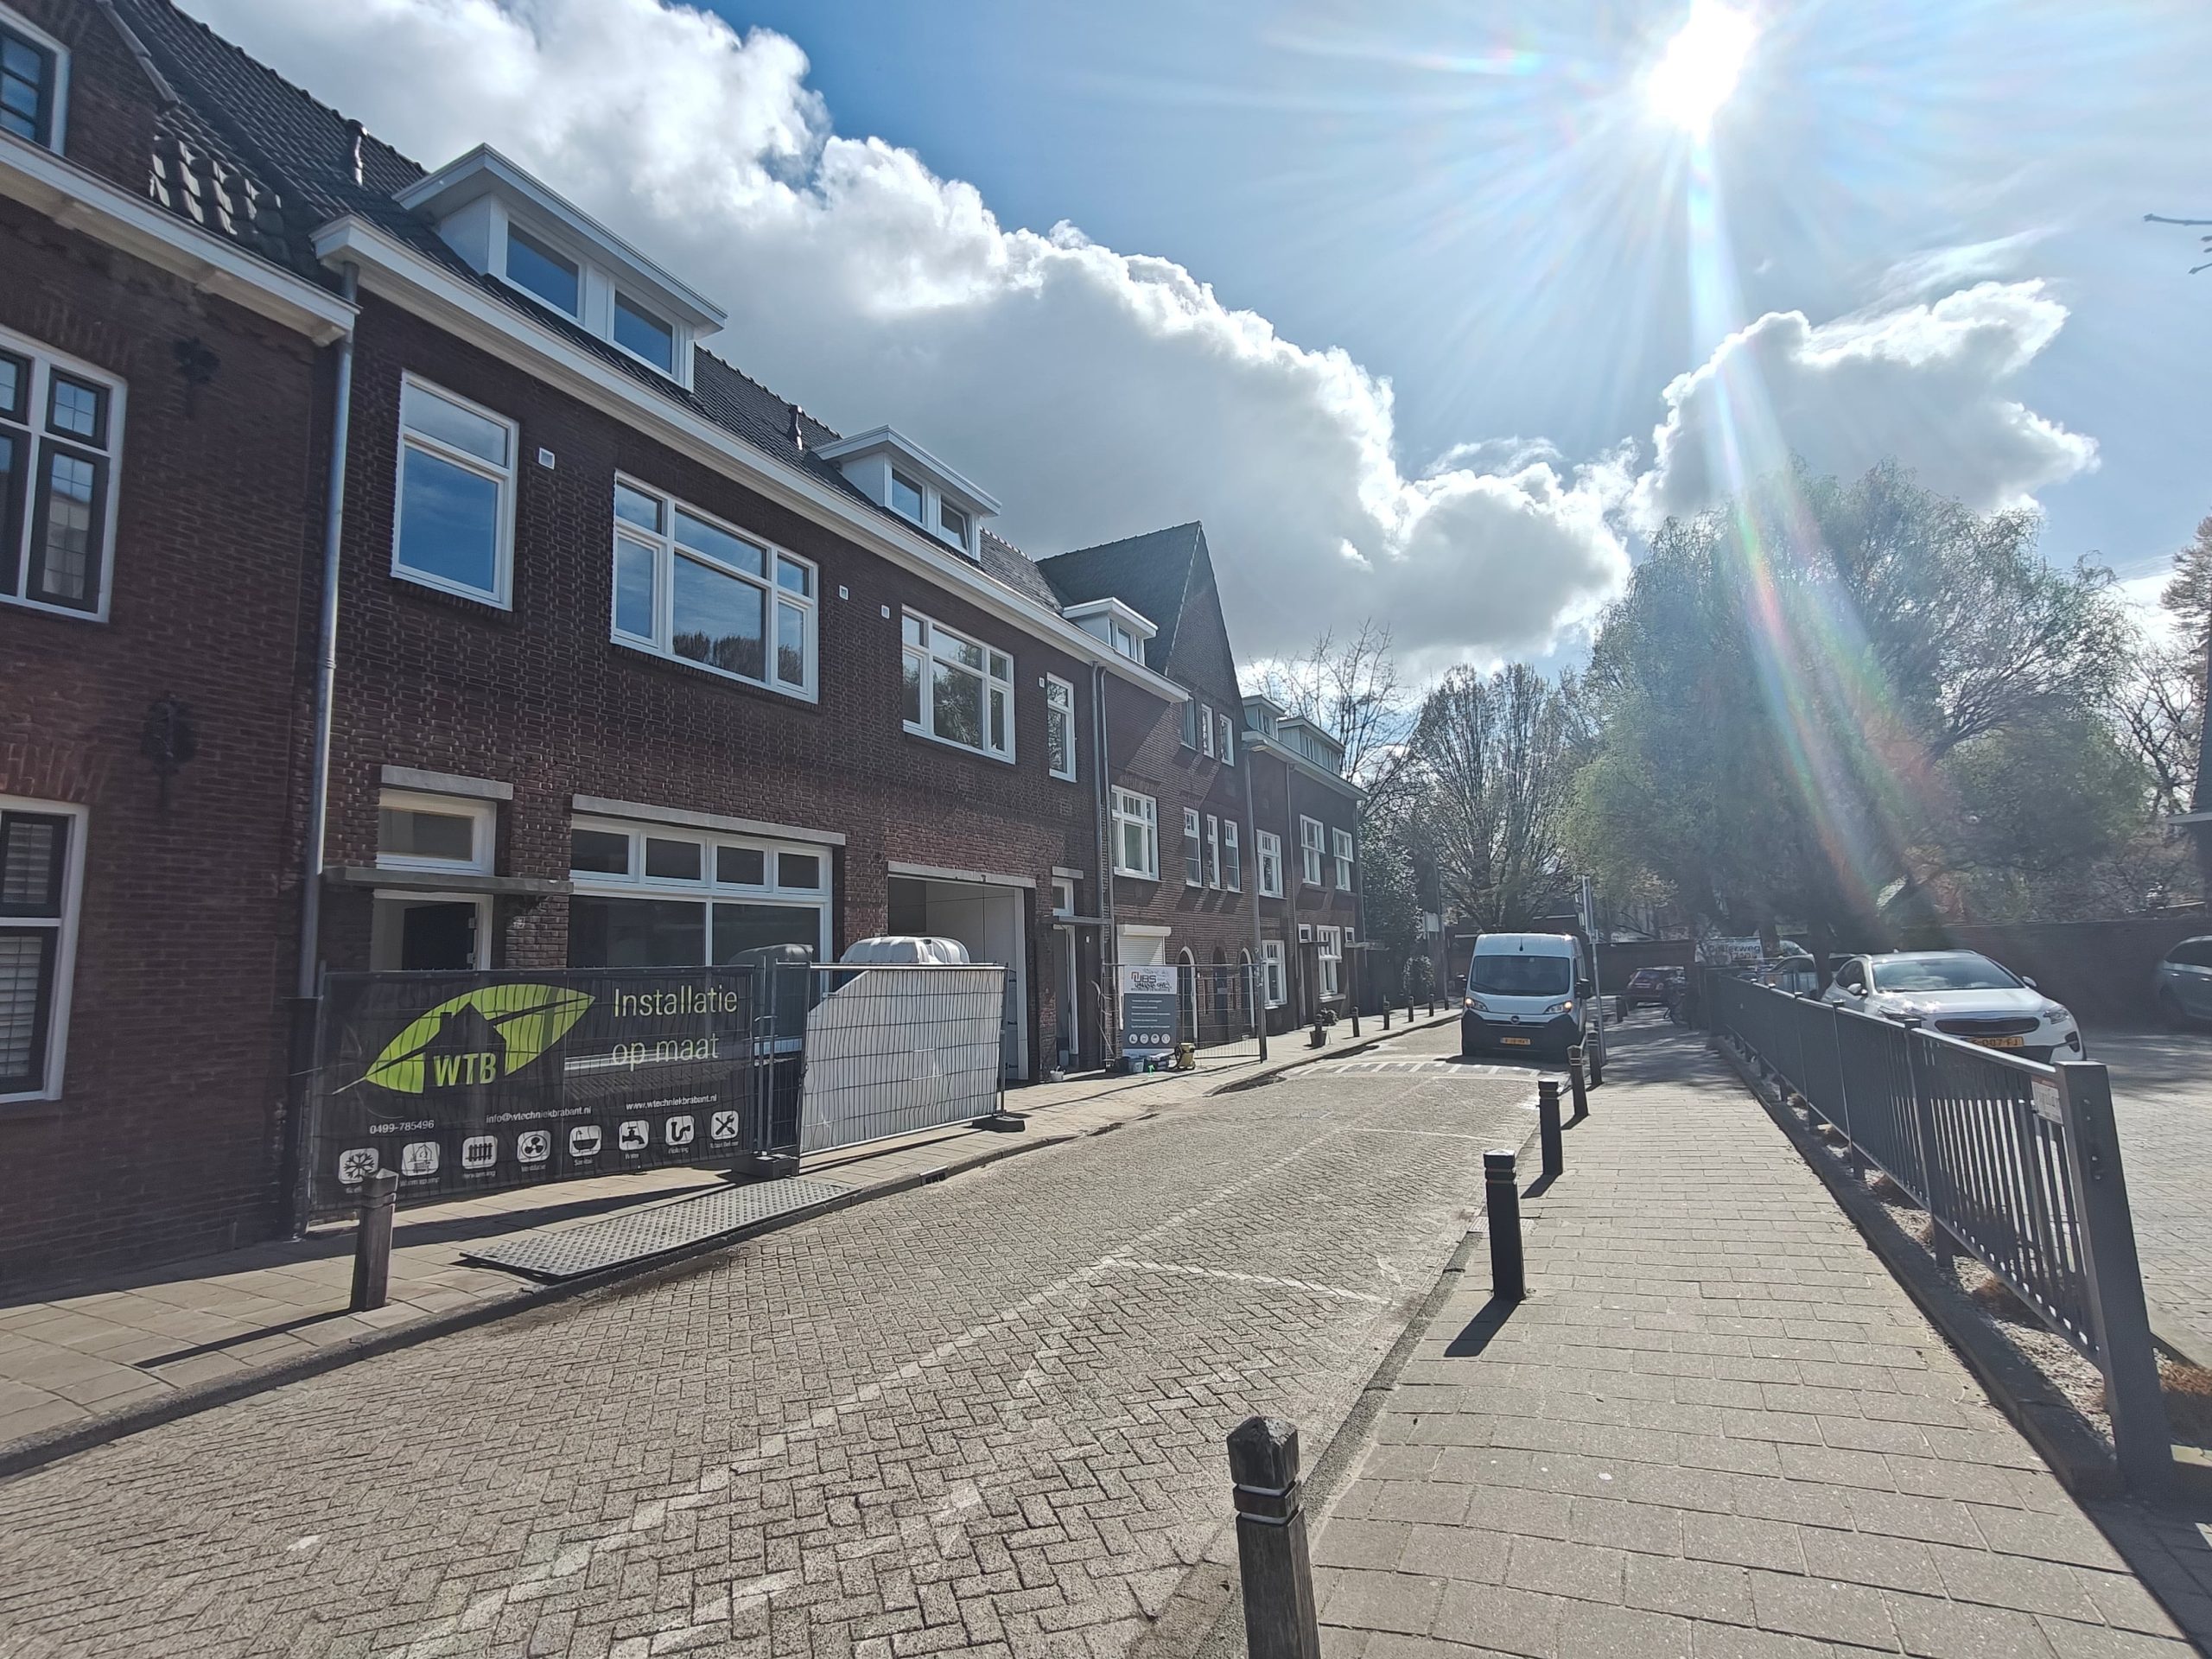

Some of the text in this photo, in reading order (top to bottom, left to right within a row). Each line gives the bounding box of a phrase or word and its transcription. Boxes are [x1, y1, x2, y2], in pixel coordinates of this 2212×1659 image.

[614, 983, 738, 1017] Installatie
[612, 1033, 720, 1071] op maat
[433, 1052, 497, 1087] WTB
[626, 1094, 717, 1110] www.wtechniekbrabant.nl
[369, 1120, 435, 1135] 0499-785496
